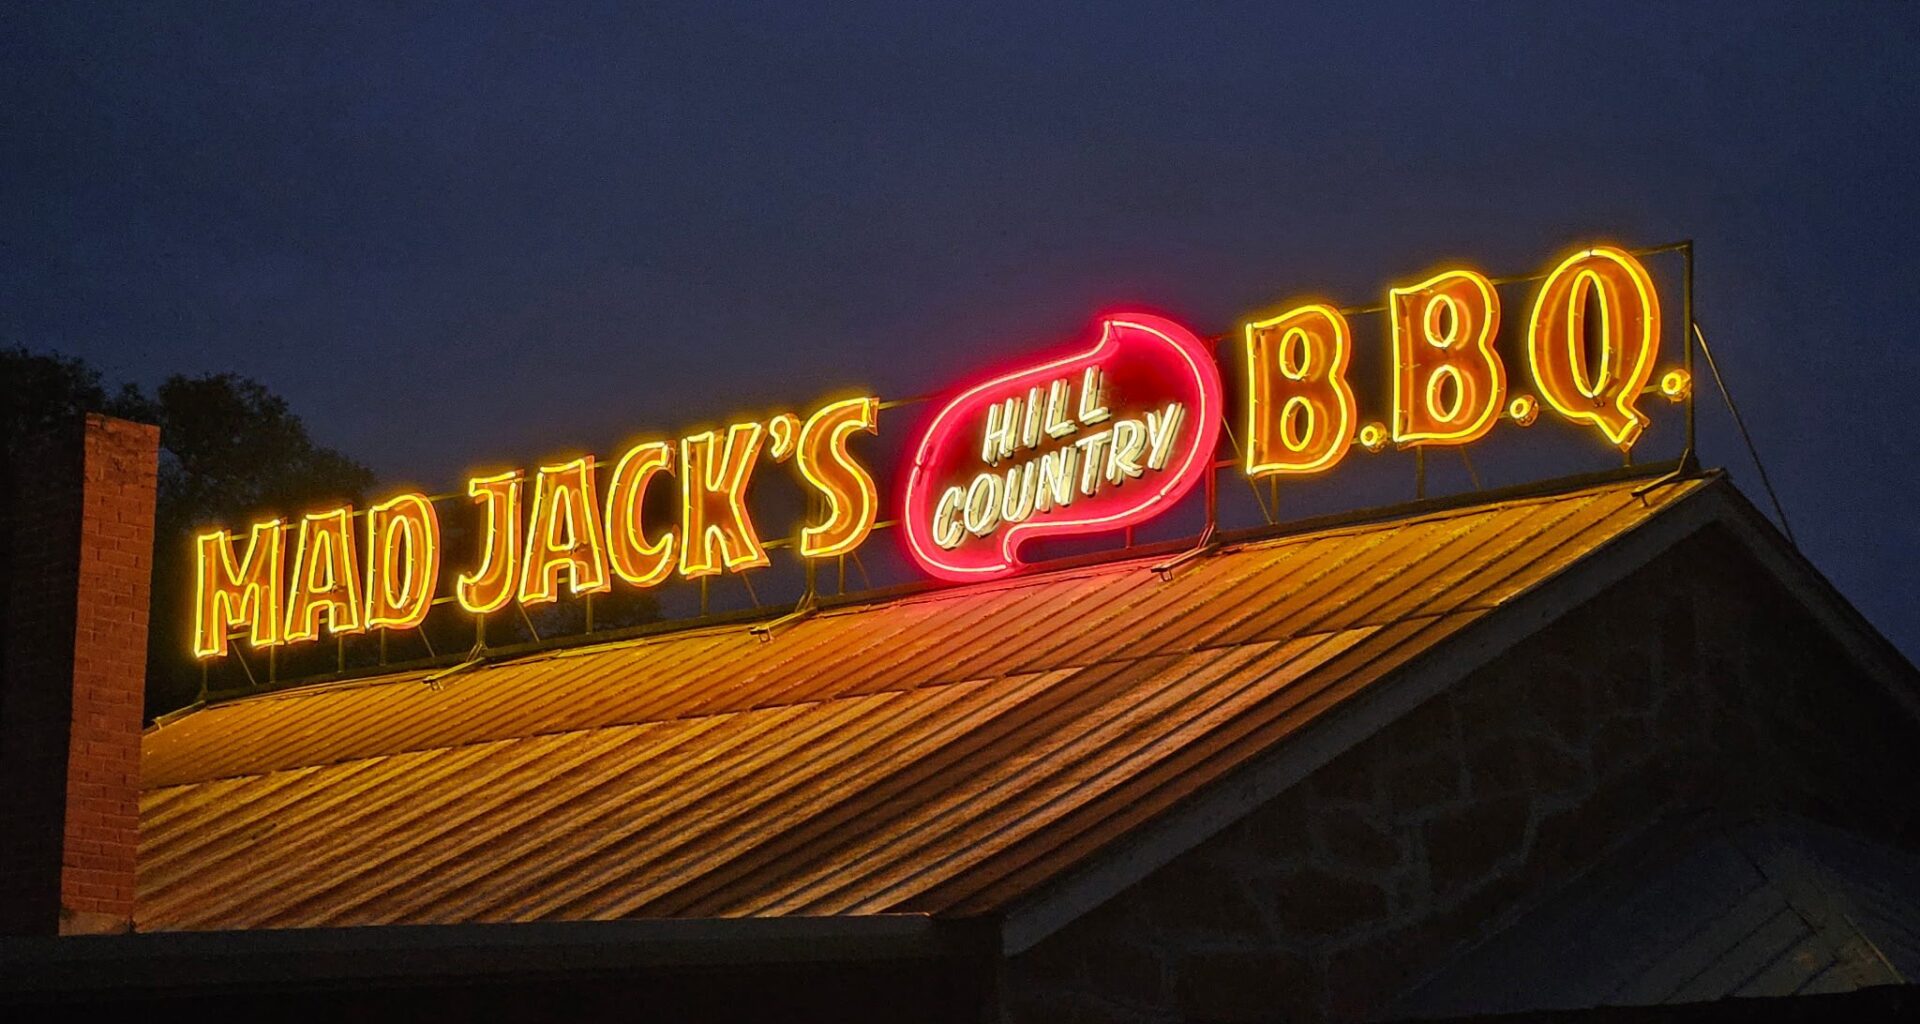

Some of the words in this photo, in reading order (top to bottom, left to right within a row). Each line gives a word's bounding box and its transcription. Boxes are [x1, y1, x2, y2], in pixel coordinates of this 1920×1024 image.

[982, 365, 1111, 467] HILL
[1246, 246, 1692, 479] B.B.Q.
[193, 492, 440, 659] MAD
[456, 396, 880, 614] JACK'S
[932, 402, 1185, 550] COUNTRY
